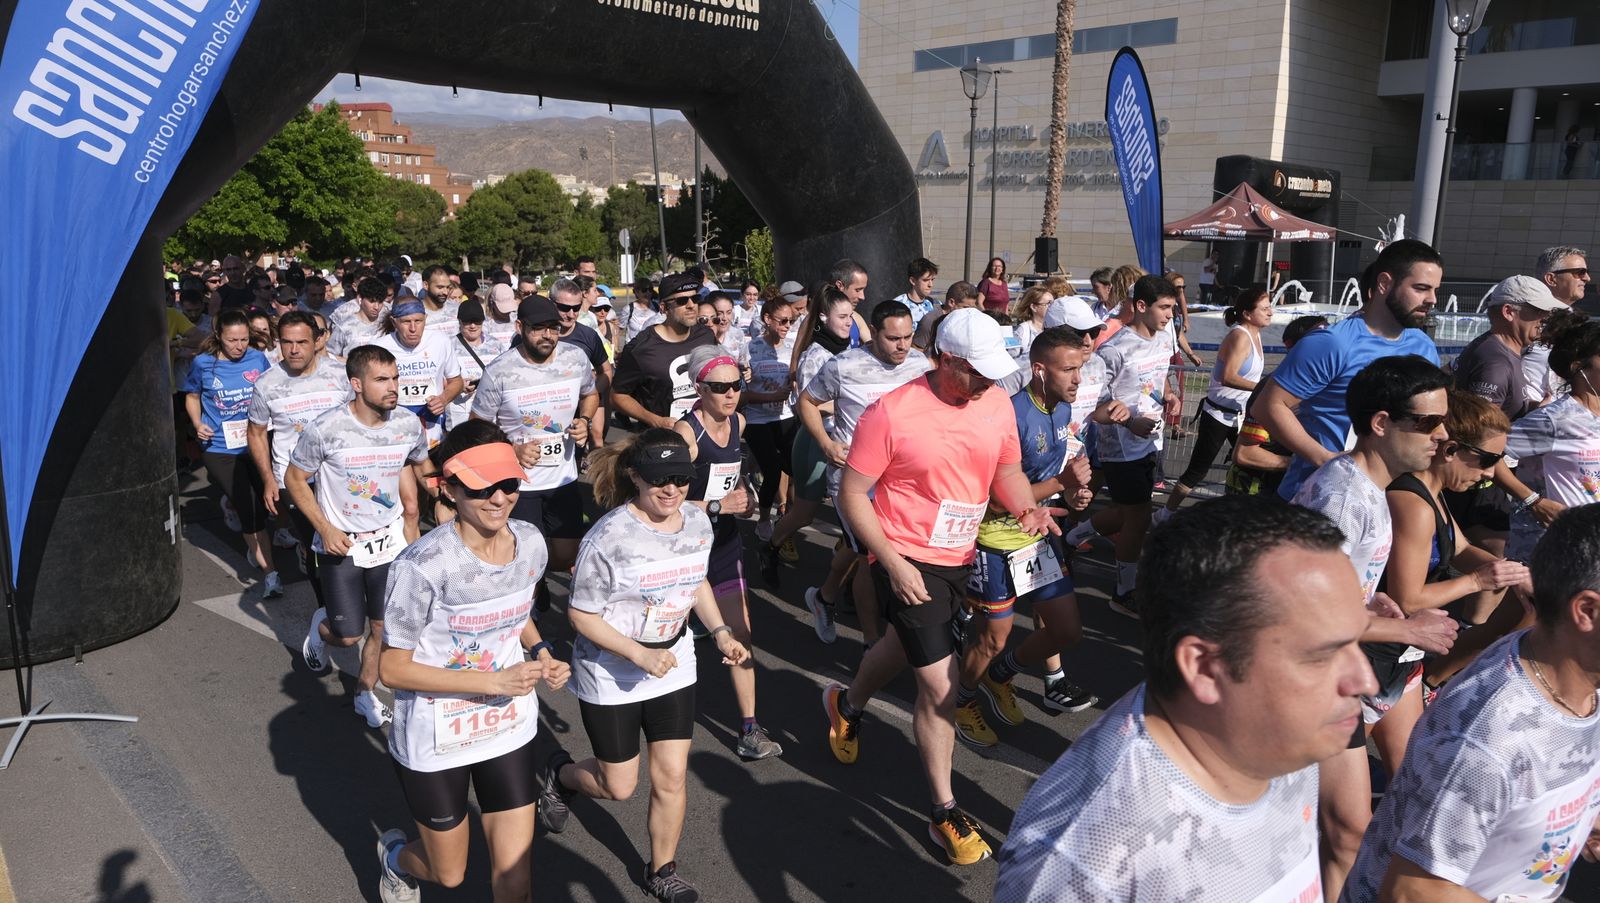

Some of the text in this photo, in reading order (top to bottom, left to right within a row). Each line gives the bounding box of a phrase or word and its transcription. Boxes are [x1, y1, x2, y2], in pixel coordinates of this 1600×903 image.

[699, 8, 760, 31] deportivo
[402, 385, 428, 396] 137
[945, 517, 980, 533] 115
[1026, 556, 1042, 575] 41
[449, 703, 518, 736] 1164
